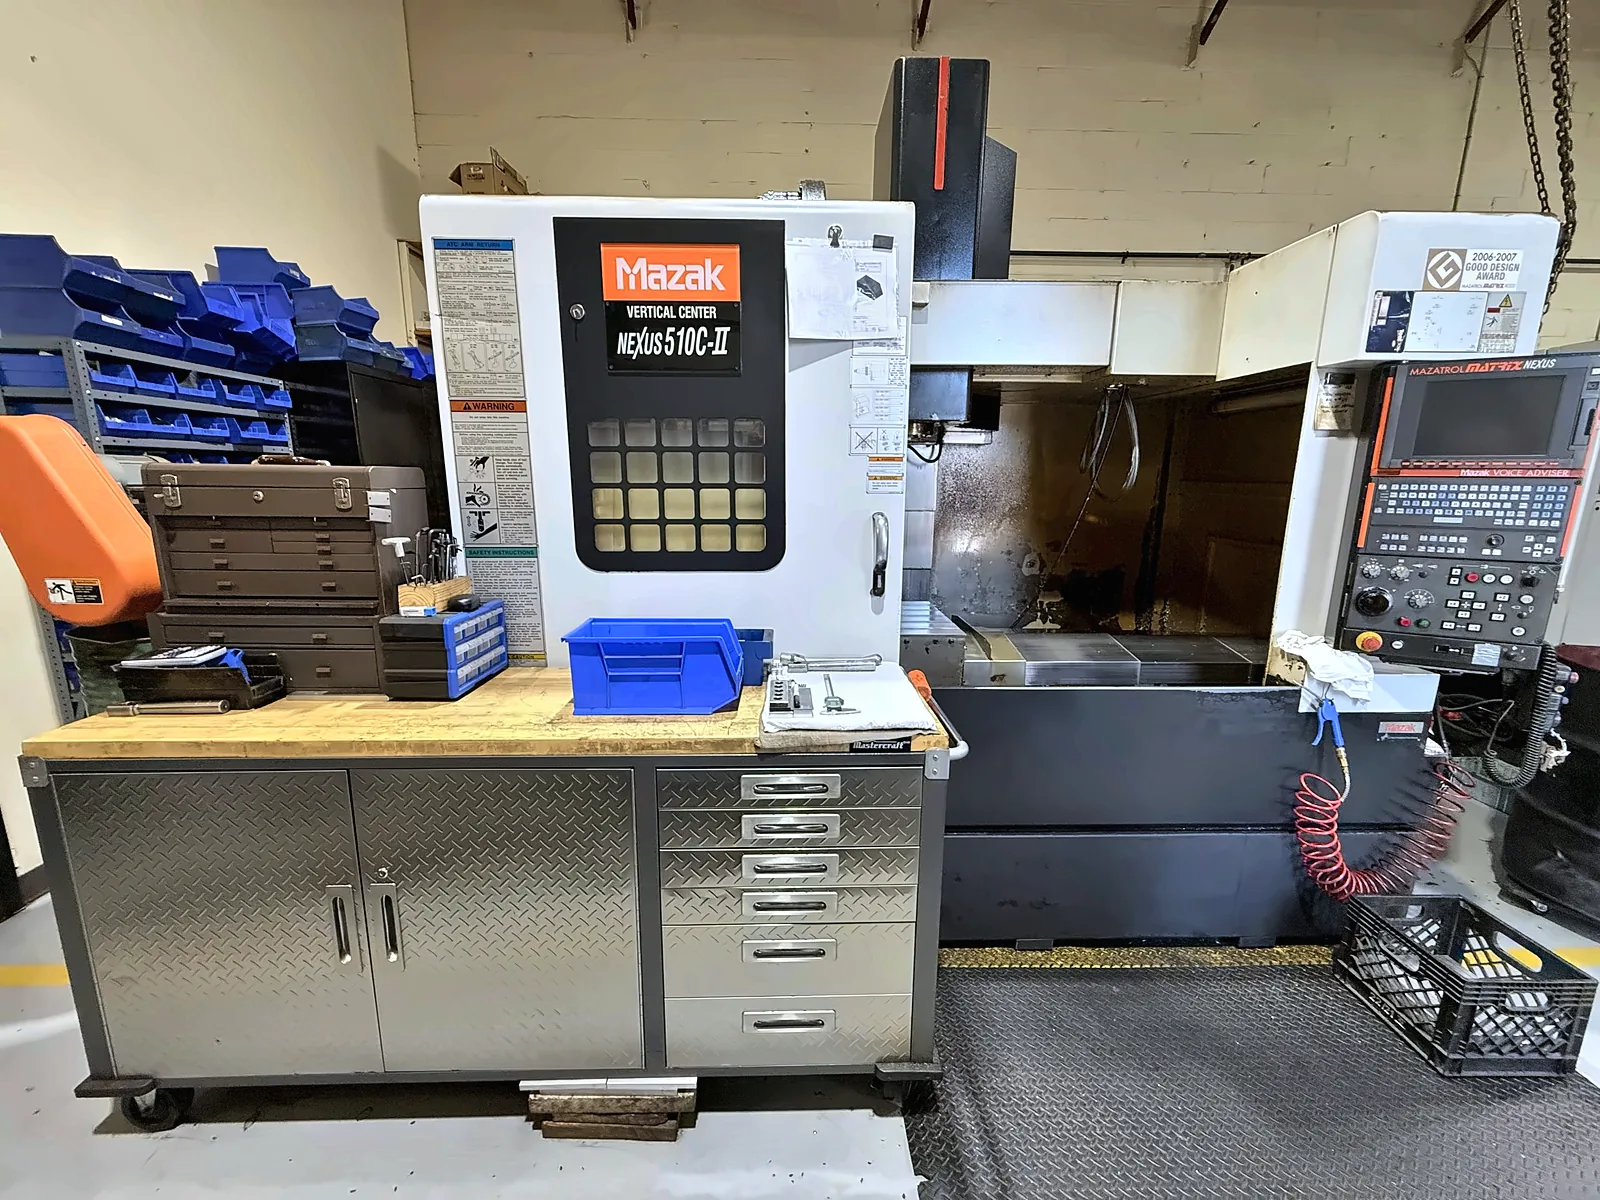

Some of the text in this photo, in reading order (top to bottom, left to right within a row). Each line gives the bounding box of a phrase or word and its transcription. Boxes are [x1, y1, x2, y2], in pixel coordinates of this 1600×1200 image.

[1472, 252, 1518, 262] 2006-2007
[1465, 262, 1520, 272] GOOD DESIGN
[615, 257, 727, 292] Mazak
[1476, 272, 1506, 281] AWARD
[627, 305, 717, 319] VERTICAL CENTER
[1409, 366, 1465, 376] MAZATROL
[1523, 359, 1556, 370] NEXUS
[472, 402, 515, 411] WARNING
[1524, 469, 1570, 477] ADVISER
[1385, 723, 1417, 732] Mazak
[852, 741, 904, 750] Mastercraft
